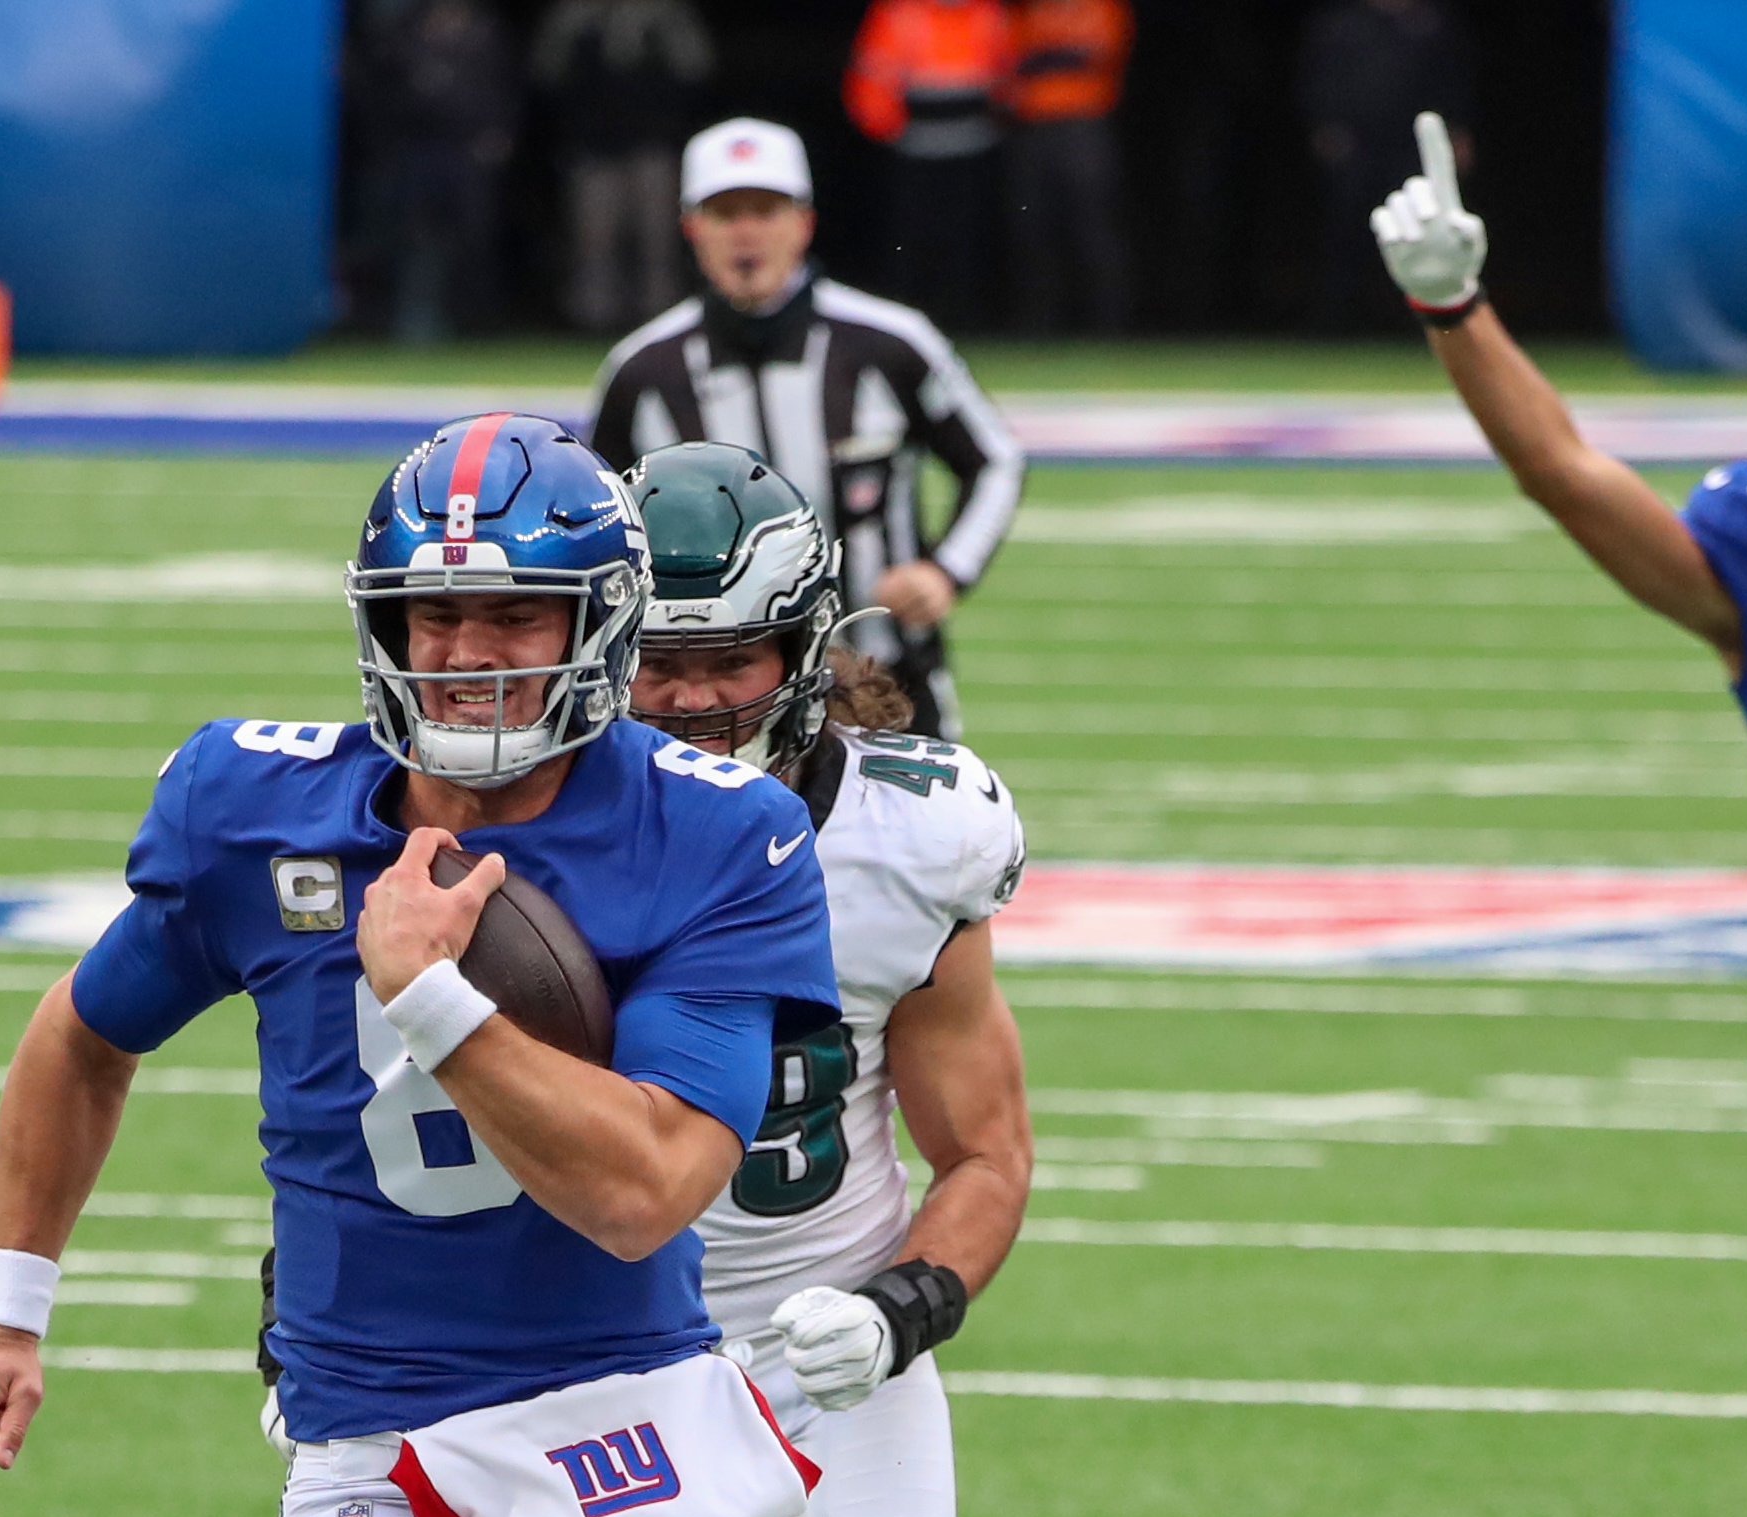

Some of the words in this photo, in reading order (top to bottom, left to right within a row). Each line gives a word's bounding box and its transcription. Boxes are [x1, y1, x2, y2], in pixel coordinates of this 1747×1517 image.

[447, 494, 476, 540] 8
[232, 719, 346, 760] 8
[654, 739, 765, 790] 8
[275, 859, 341, 911] C
[354, 978, 525, 1217] 8
